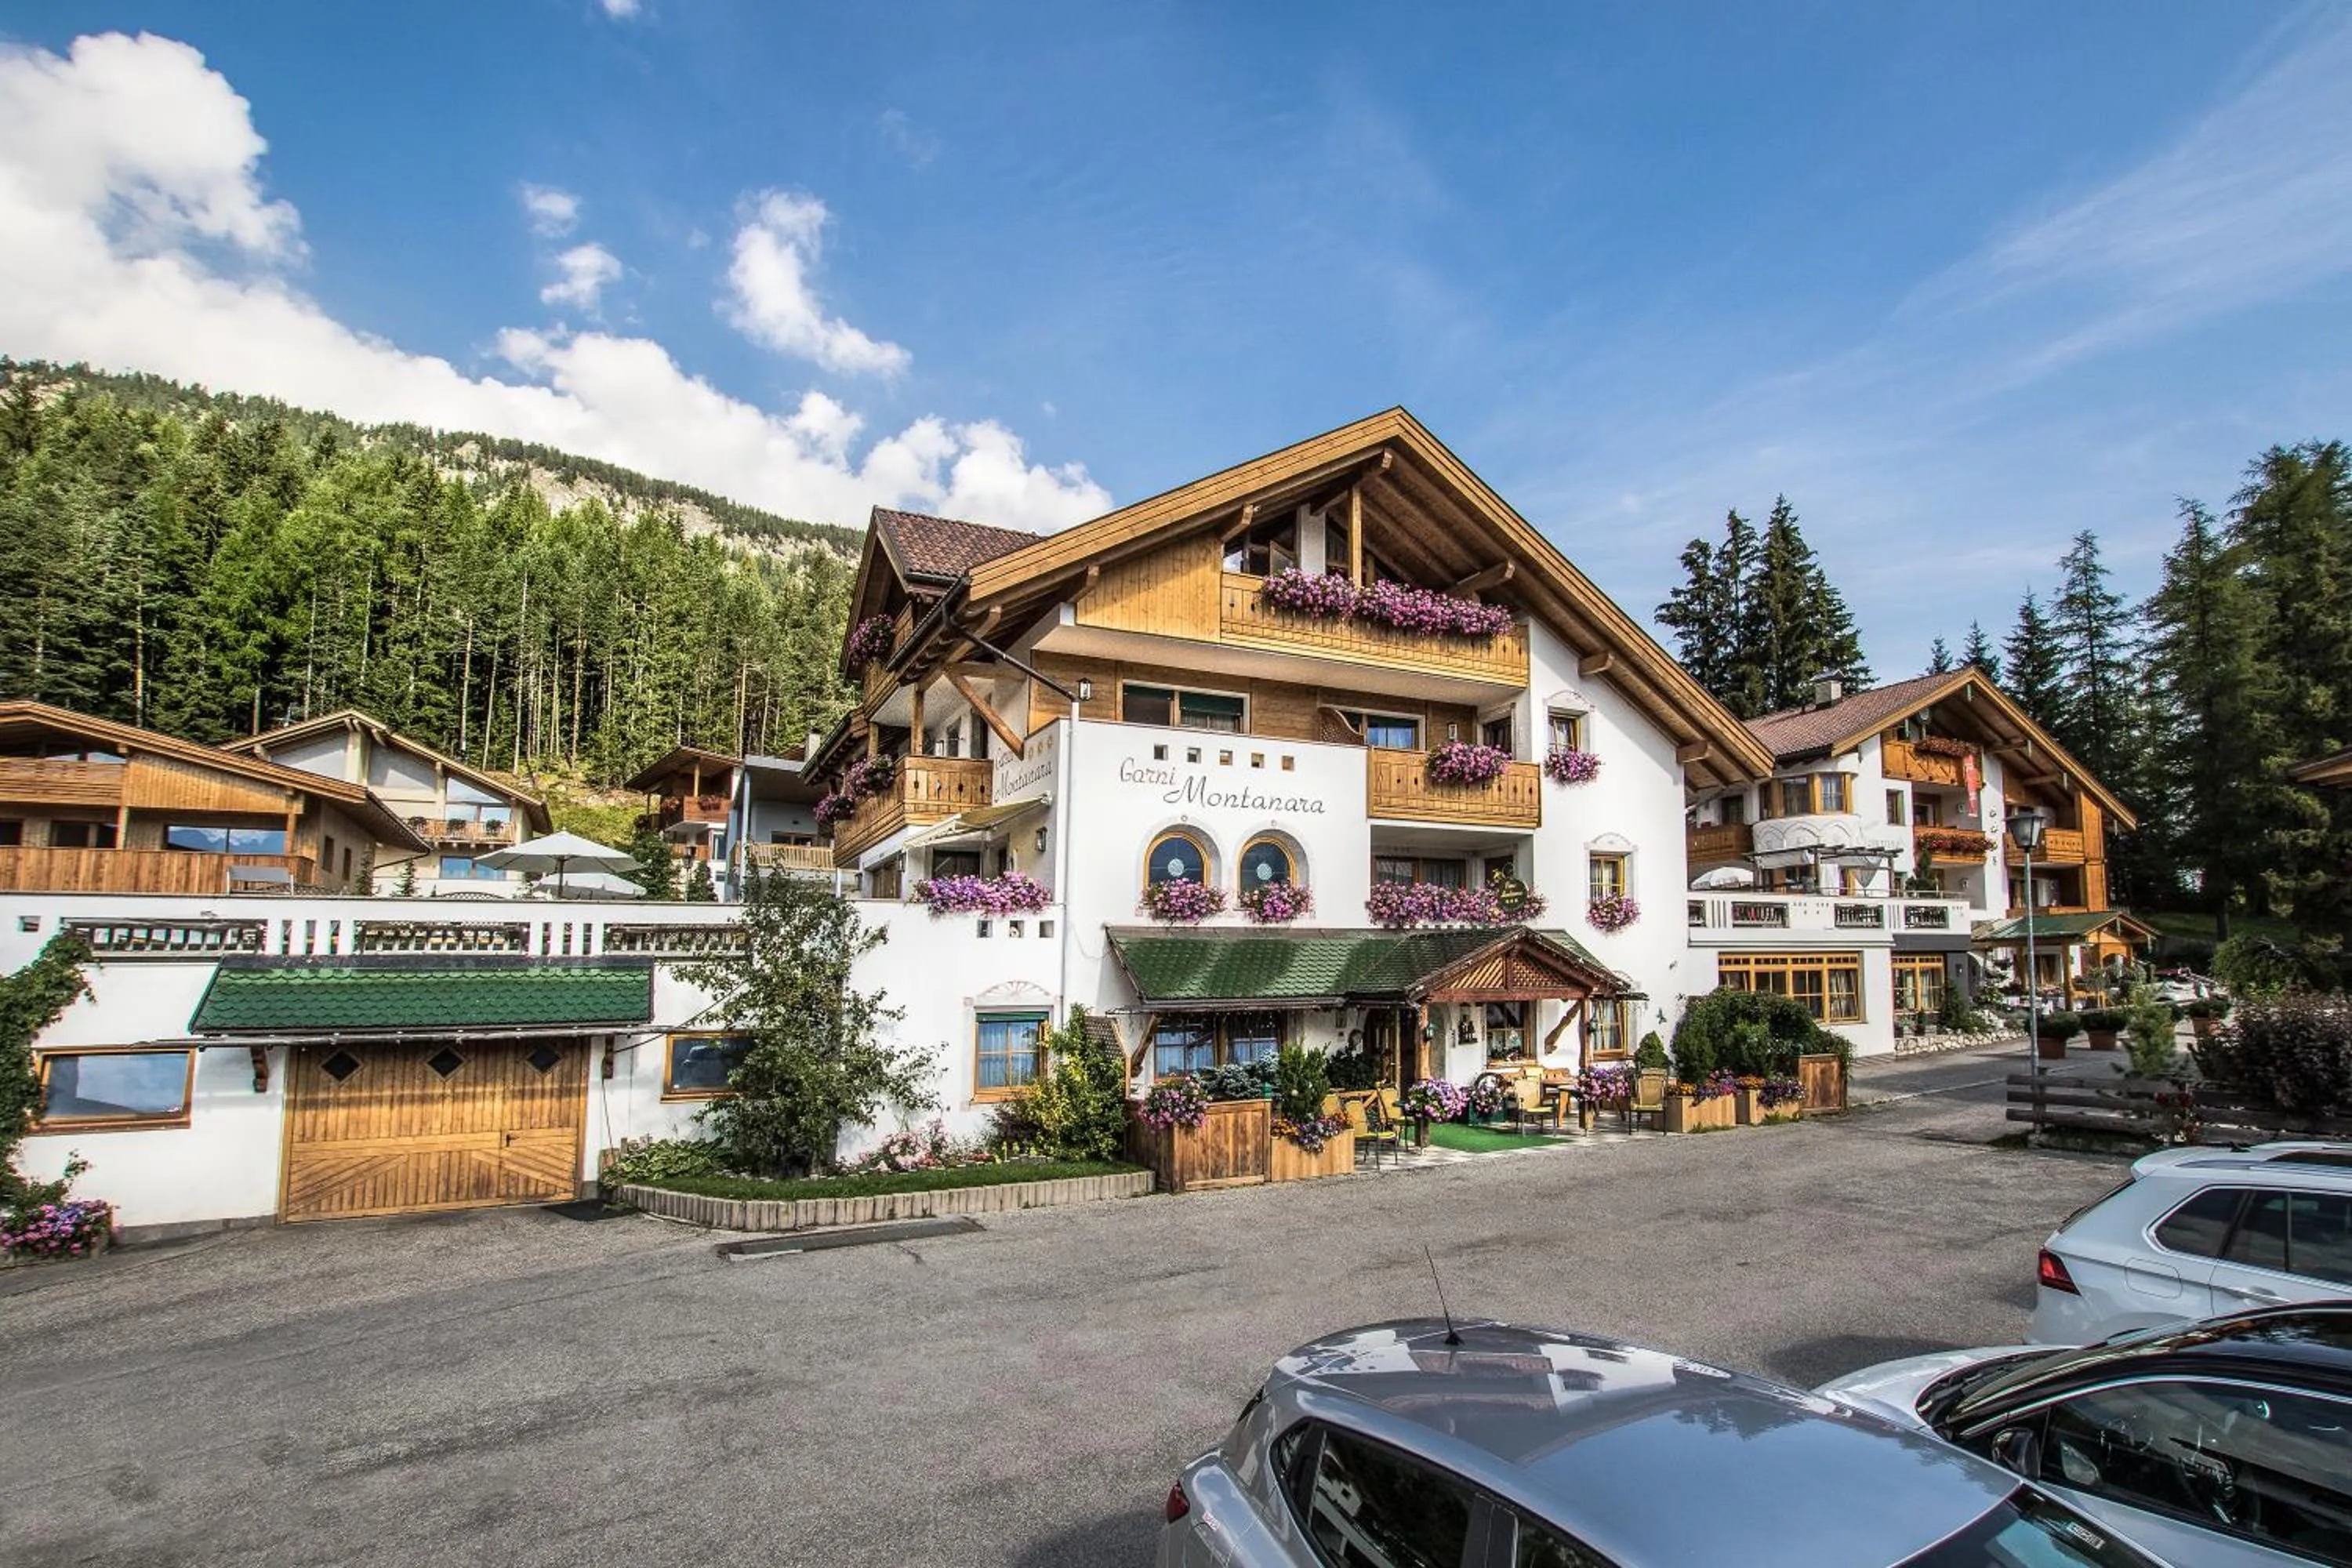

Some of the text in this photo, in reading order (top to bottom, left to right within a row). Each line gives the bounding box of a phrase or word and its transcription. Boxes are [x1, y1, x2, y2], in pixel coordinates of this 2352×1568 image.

[993, 760, 1052, 804] Montanara
[1120, 757, 1326, 815] Garni Montanara
